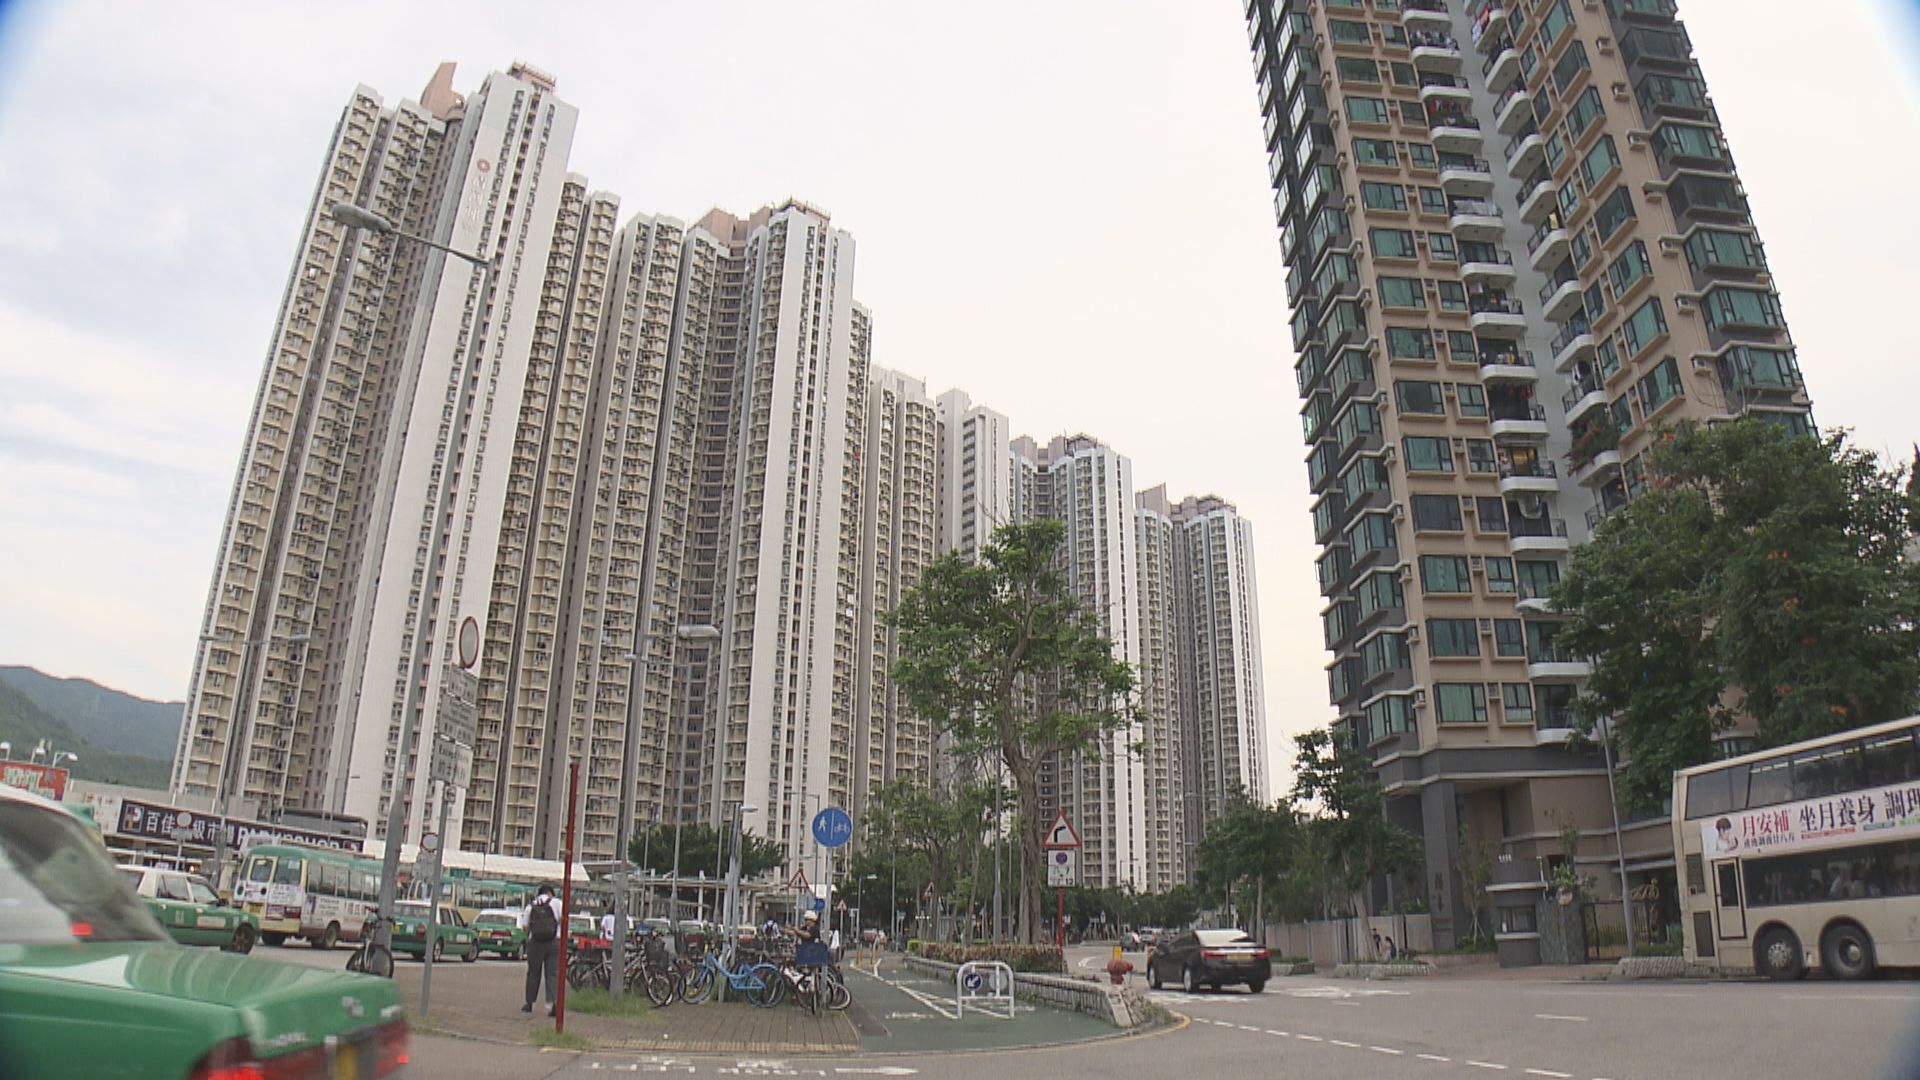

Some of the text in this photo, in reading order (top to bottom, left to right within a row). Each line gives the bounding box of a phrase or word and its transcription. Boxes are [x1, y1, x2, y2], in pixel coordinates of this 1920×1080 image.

[146, 810, 236, 845] 百佳級市場
[1742, 808, 1789, 837] 月安補
[1799, 794, 1876, 833] 坐月養身
